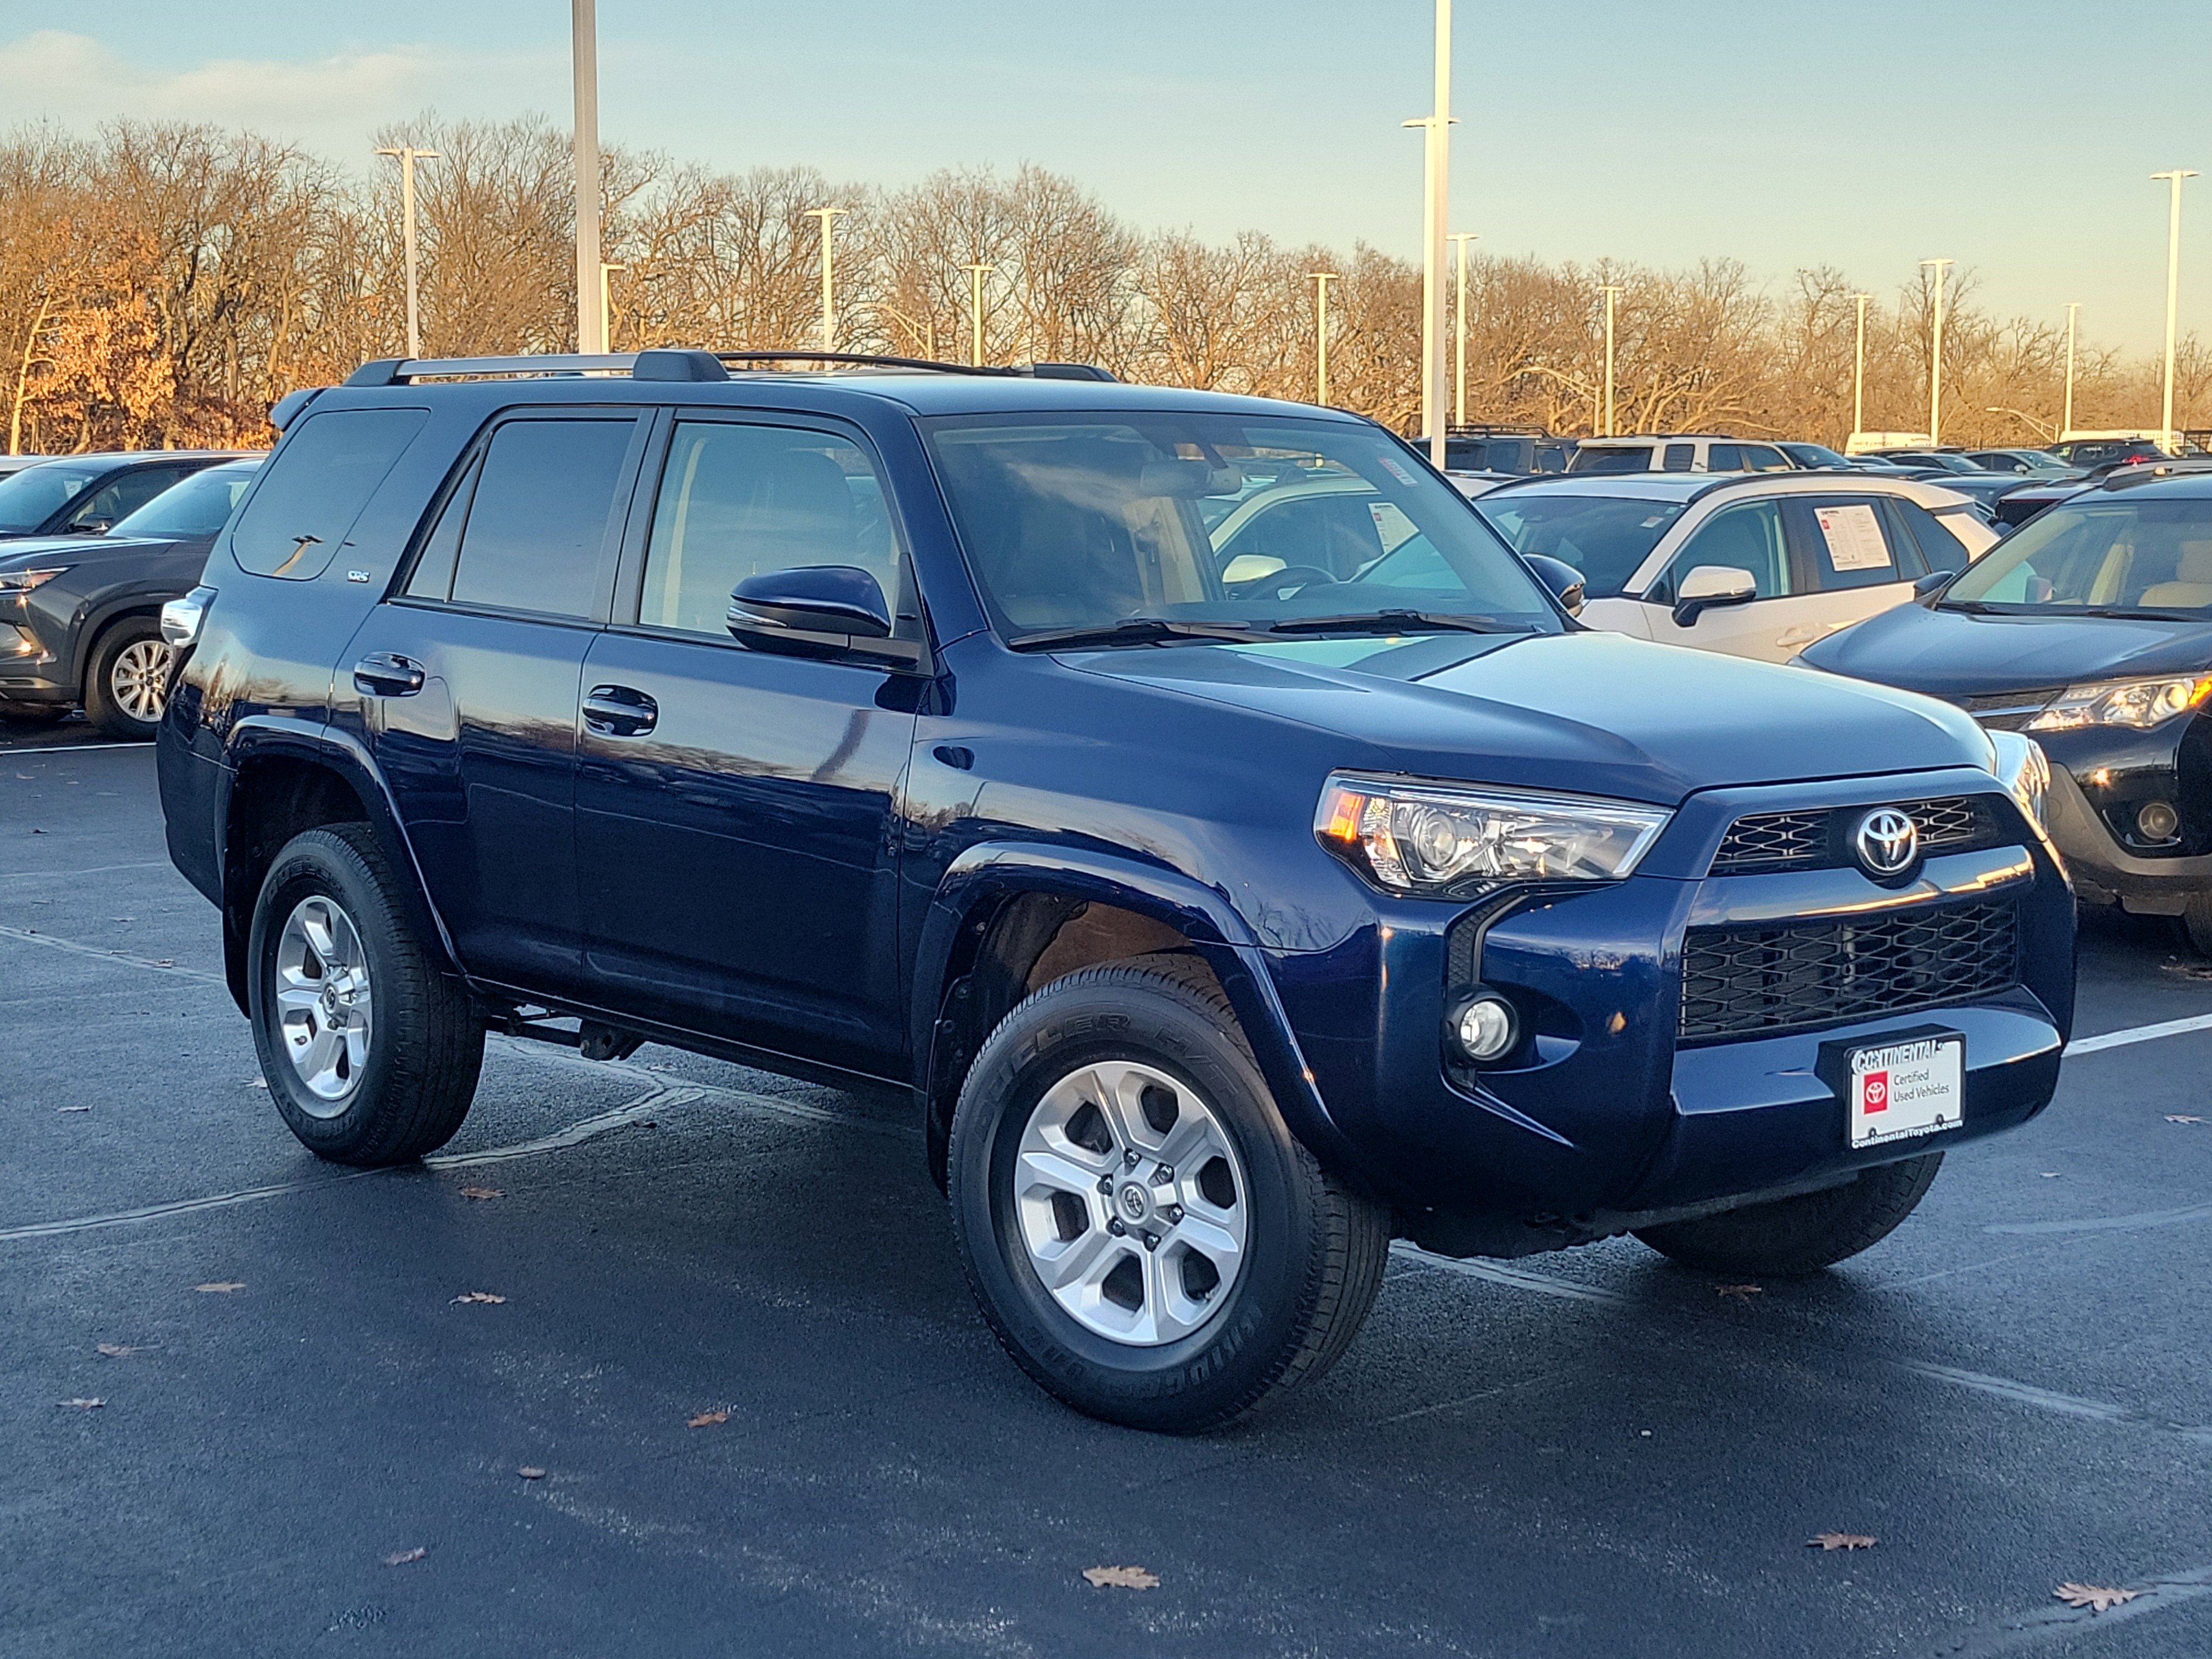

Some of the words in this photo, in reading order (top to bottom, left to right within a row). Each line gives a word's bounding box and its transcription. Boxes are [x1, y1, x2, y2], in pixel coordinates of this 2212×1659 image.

[1851, 1040, 1938, 1074] CONTINENTAL
[1894, 1069, 1929, 1085] Certified
[1893, 1089, 1914, 1103] Used
[1915, 1083, 1950, 1098] Vehicles
[1851, 1119, 1963, 1149] ContinentalToyota.com
